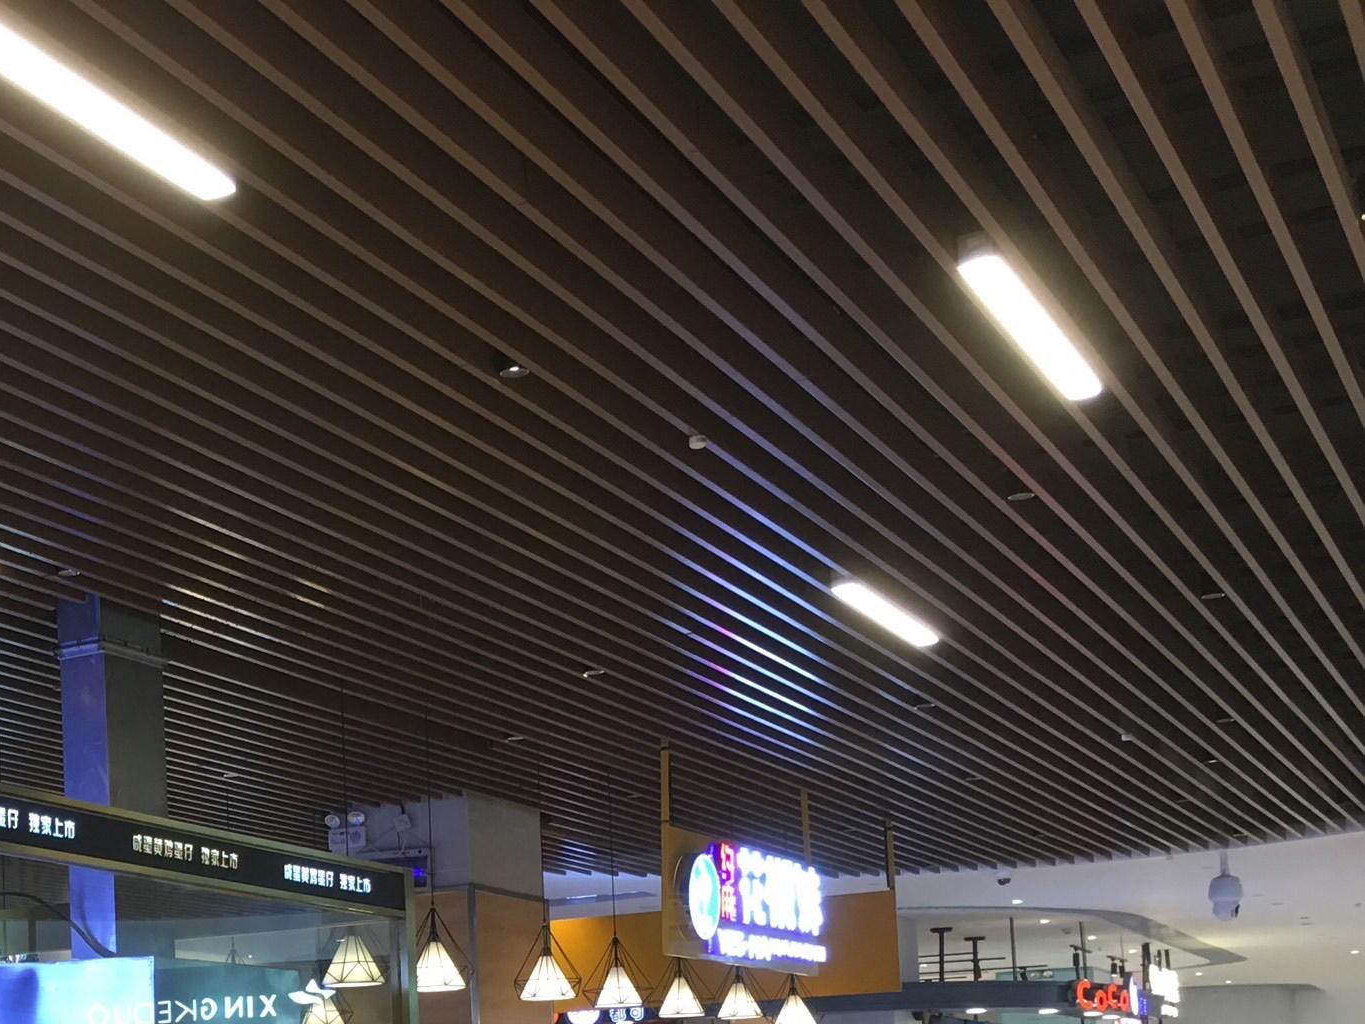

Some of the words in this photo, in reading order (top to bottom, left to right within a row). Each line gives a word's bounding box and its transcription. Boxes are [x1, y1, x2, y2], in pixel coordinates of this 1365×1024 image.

[28, 812, 76, 840] 独家上市
[200, 846, 239, 870] 独家上市
[1076, 978, 1130, 1012] CoCo
